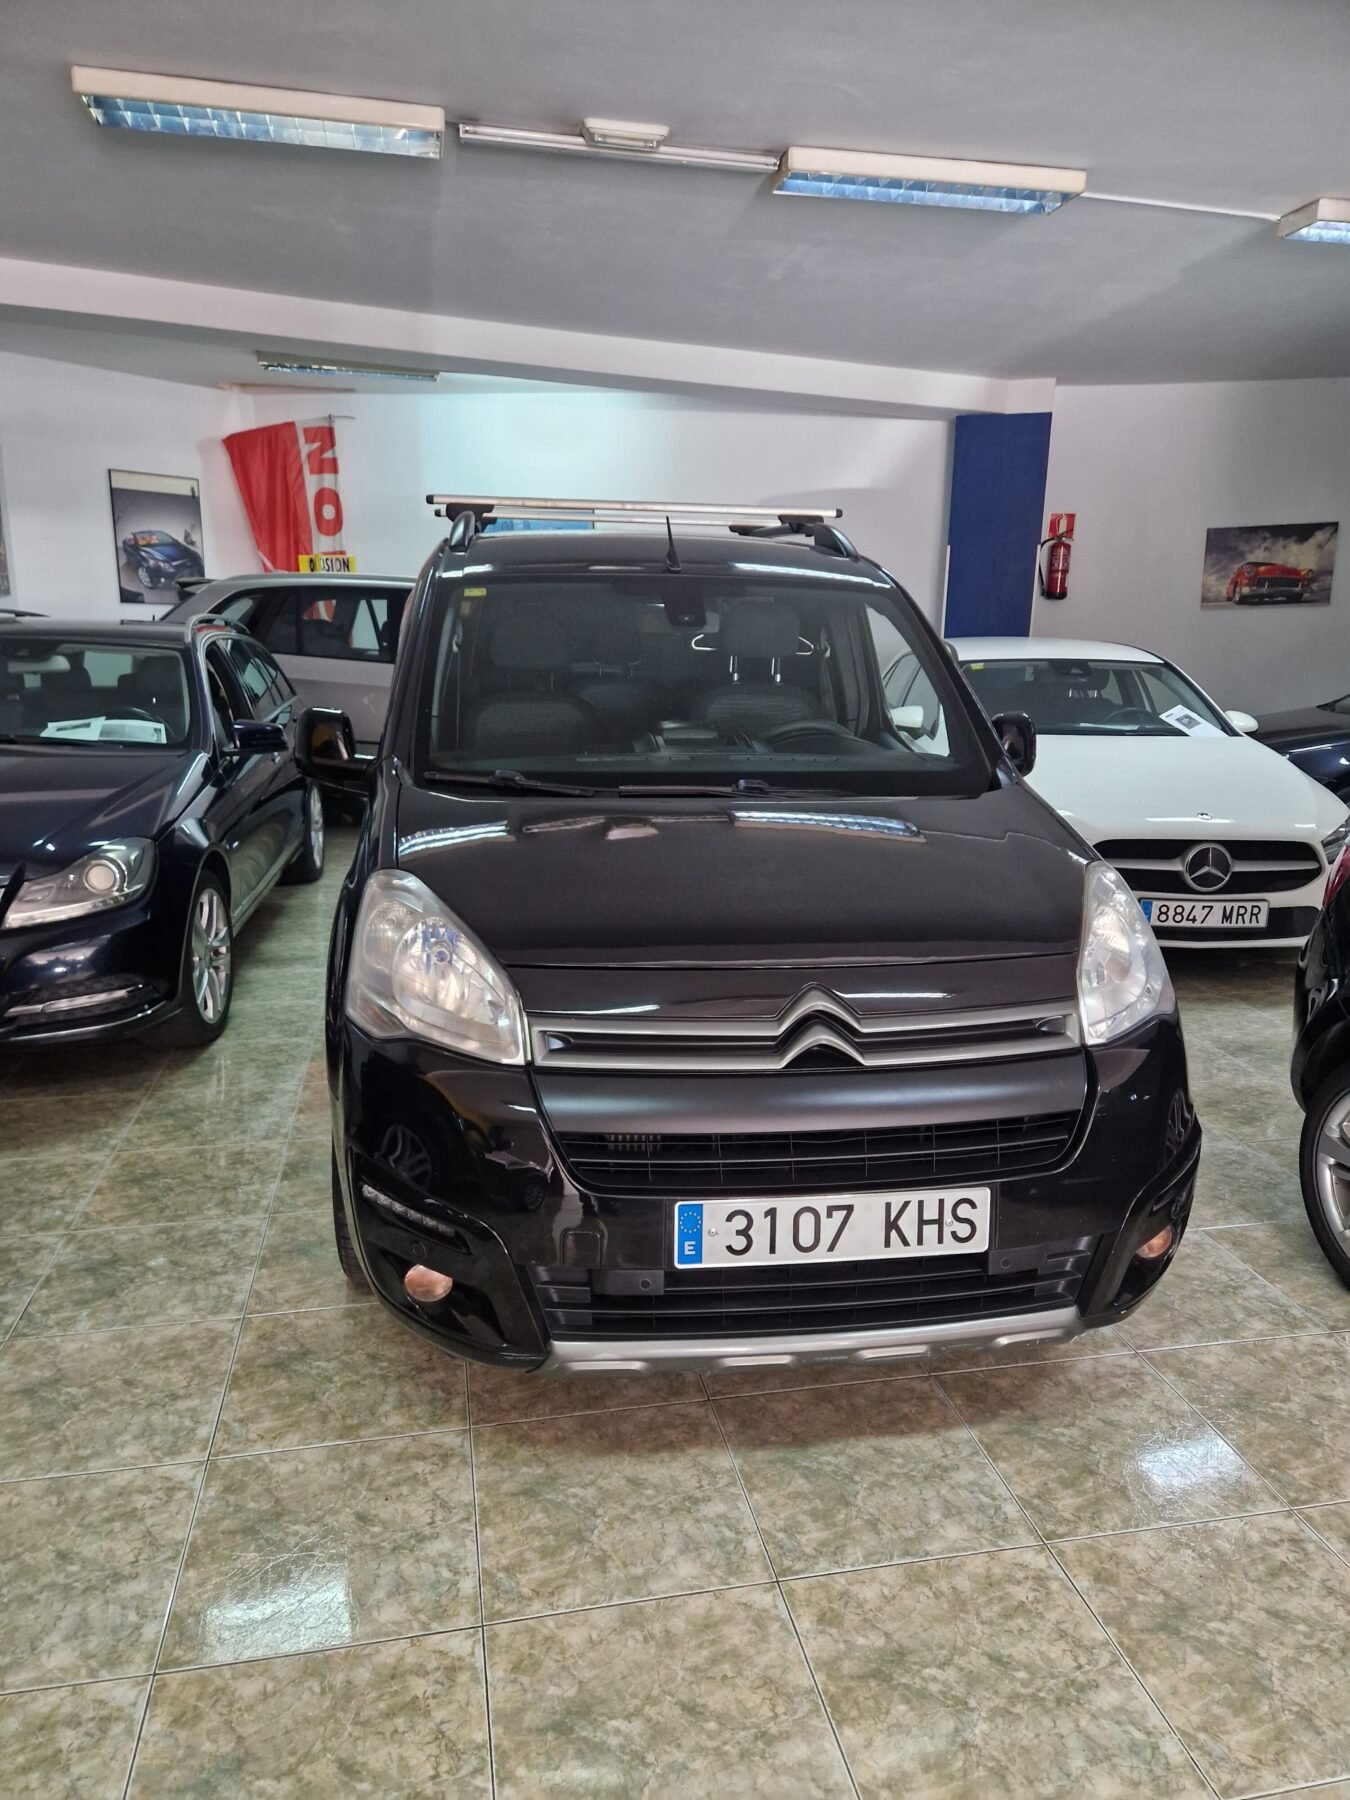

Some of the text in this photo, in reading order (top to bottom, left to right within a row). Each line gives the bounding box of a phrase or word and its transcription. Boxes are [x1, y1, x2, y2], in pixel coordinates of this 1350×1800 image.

[303, 426, 347, 555] ON
[309, 557, 350, 572] OSION
[1157, 904, 1261, 924] 8847 MRR
[684, 1197, 978, 1256] E 3107 KHS
